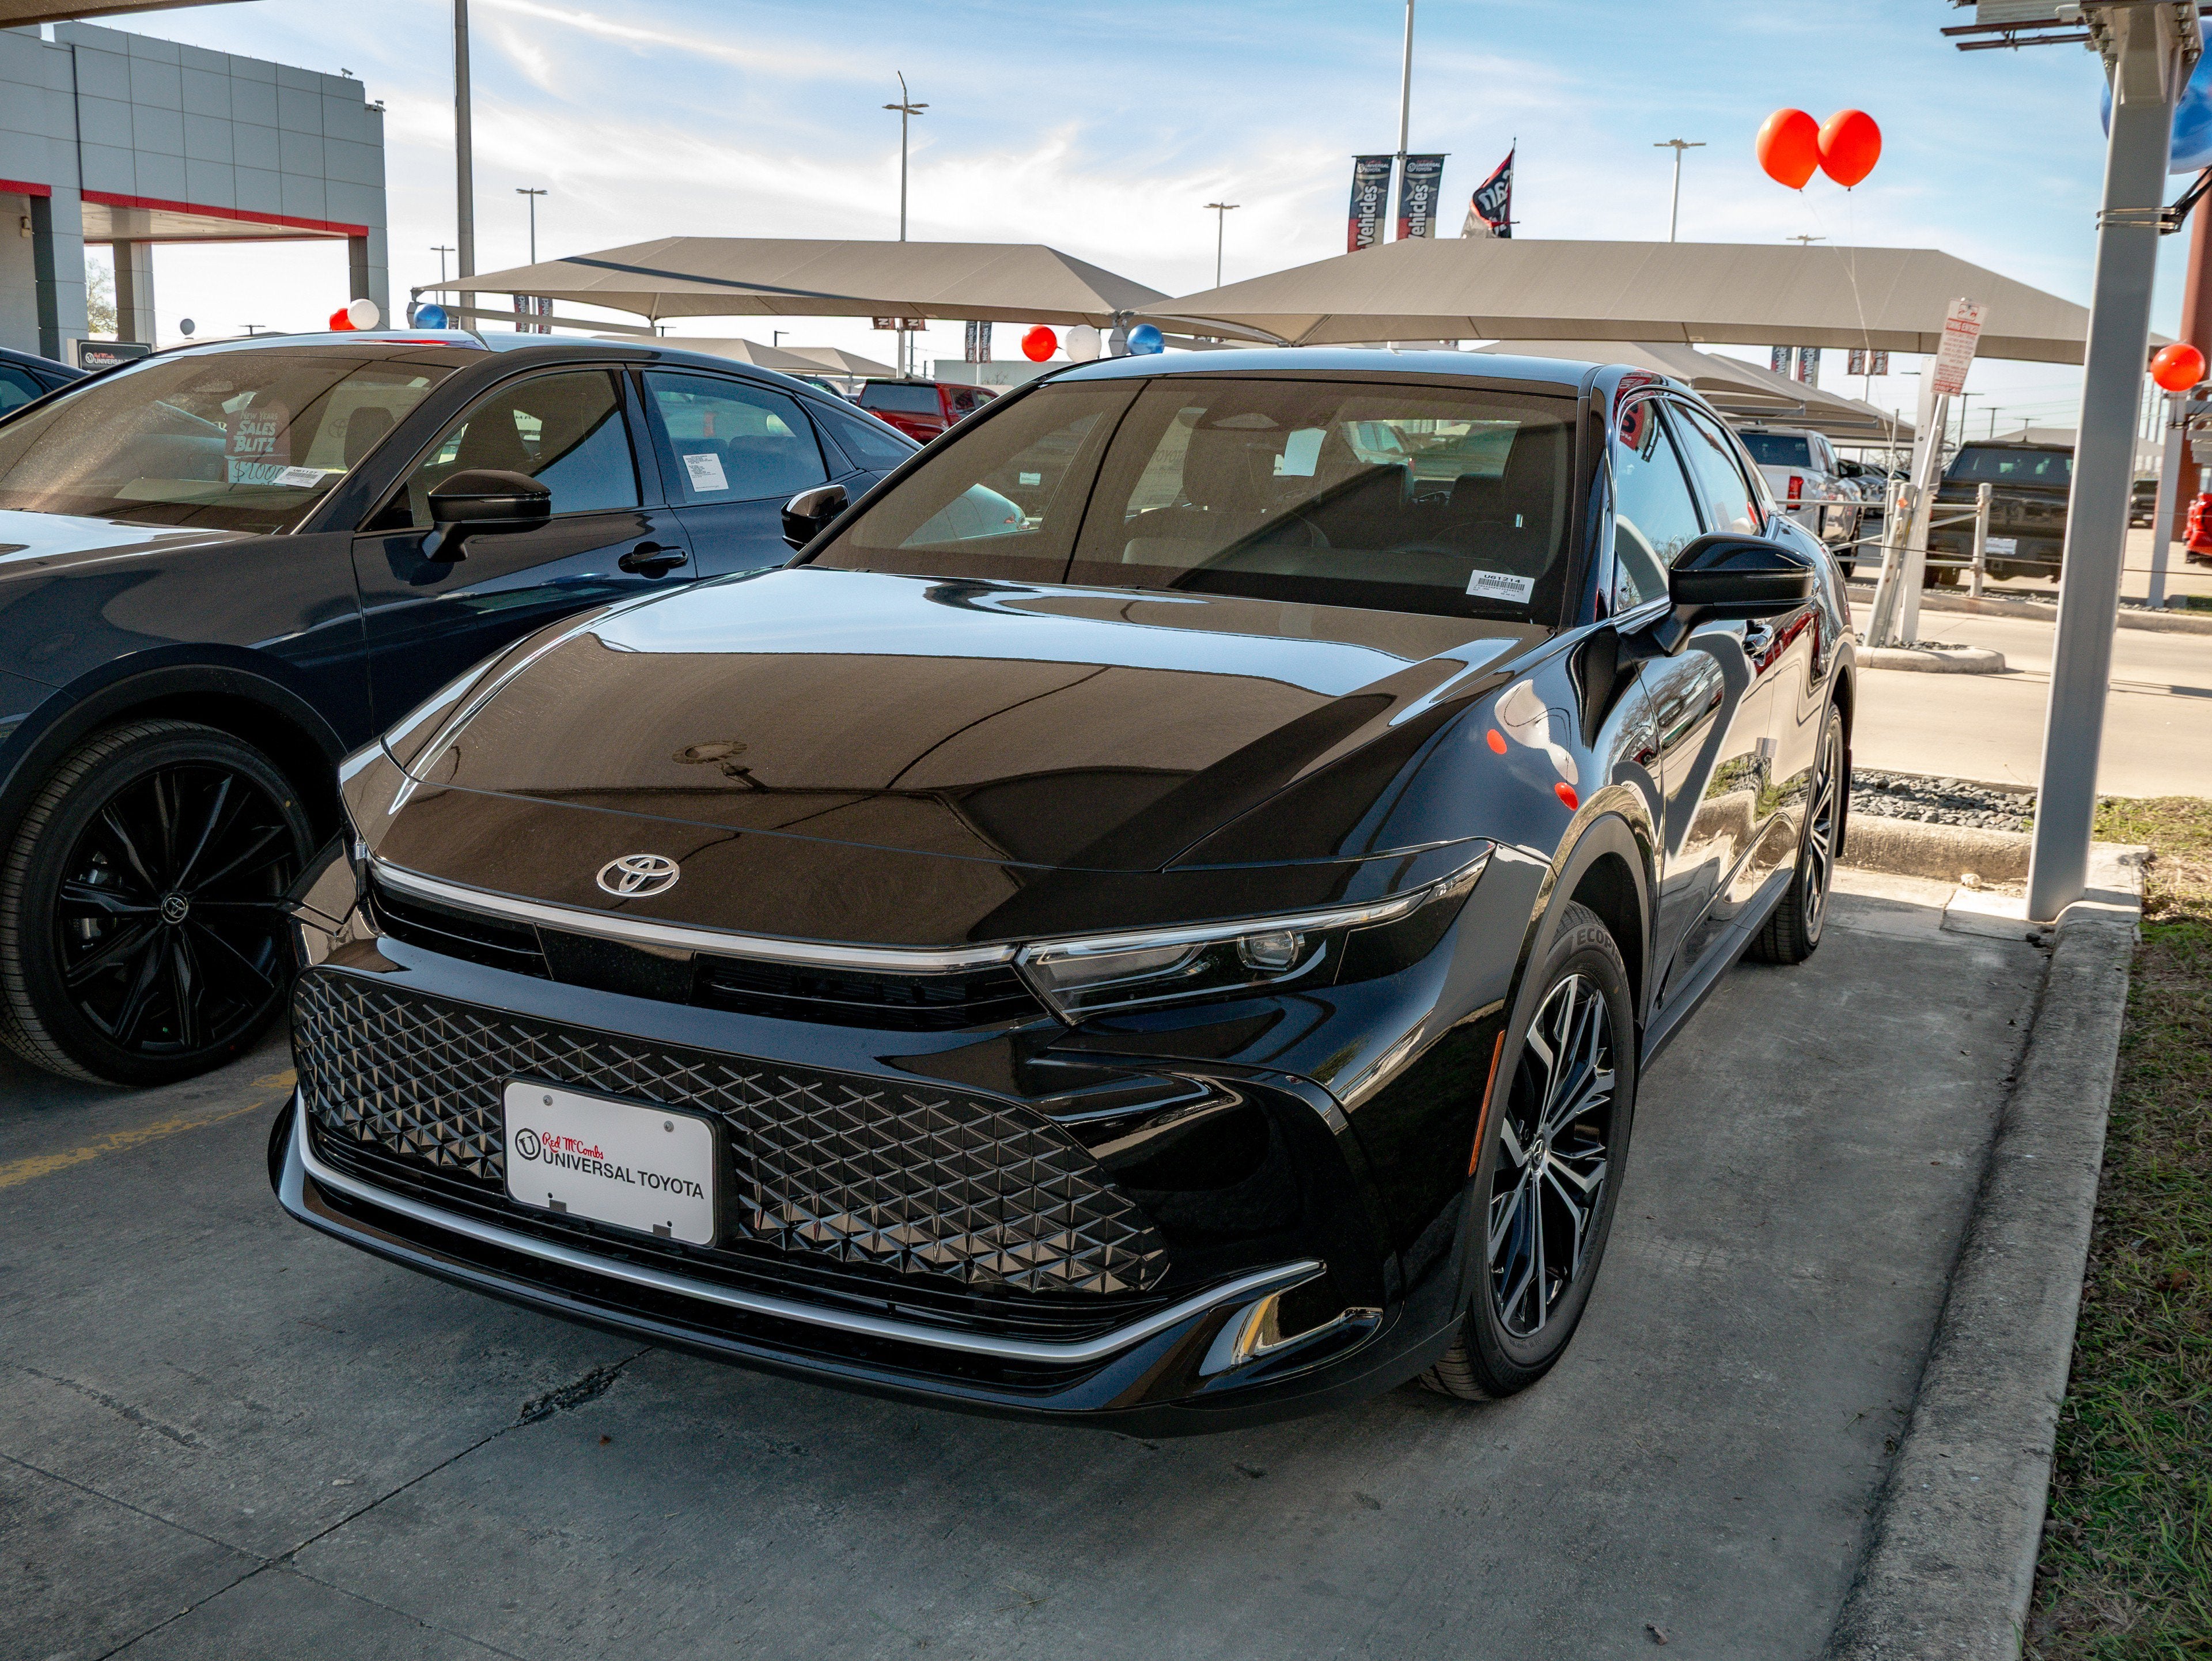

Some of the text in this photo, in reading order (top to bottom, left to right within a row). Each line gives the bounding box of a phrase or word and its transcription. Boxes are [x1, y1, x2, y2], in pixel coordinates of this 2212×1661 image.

[1357, 185, 1378, 245] Vehicles
[237, 420, 277, 436] SALES
[233, 436, 277, 453] BLITZ
[1484, 574, 1521, 583] U61214
[542, 1132, 604, 1160] Red McCombs
[543, 1148, 704, 1200] UNIVERSAL TOYOTA
